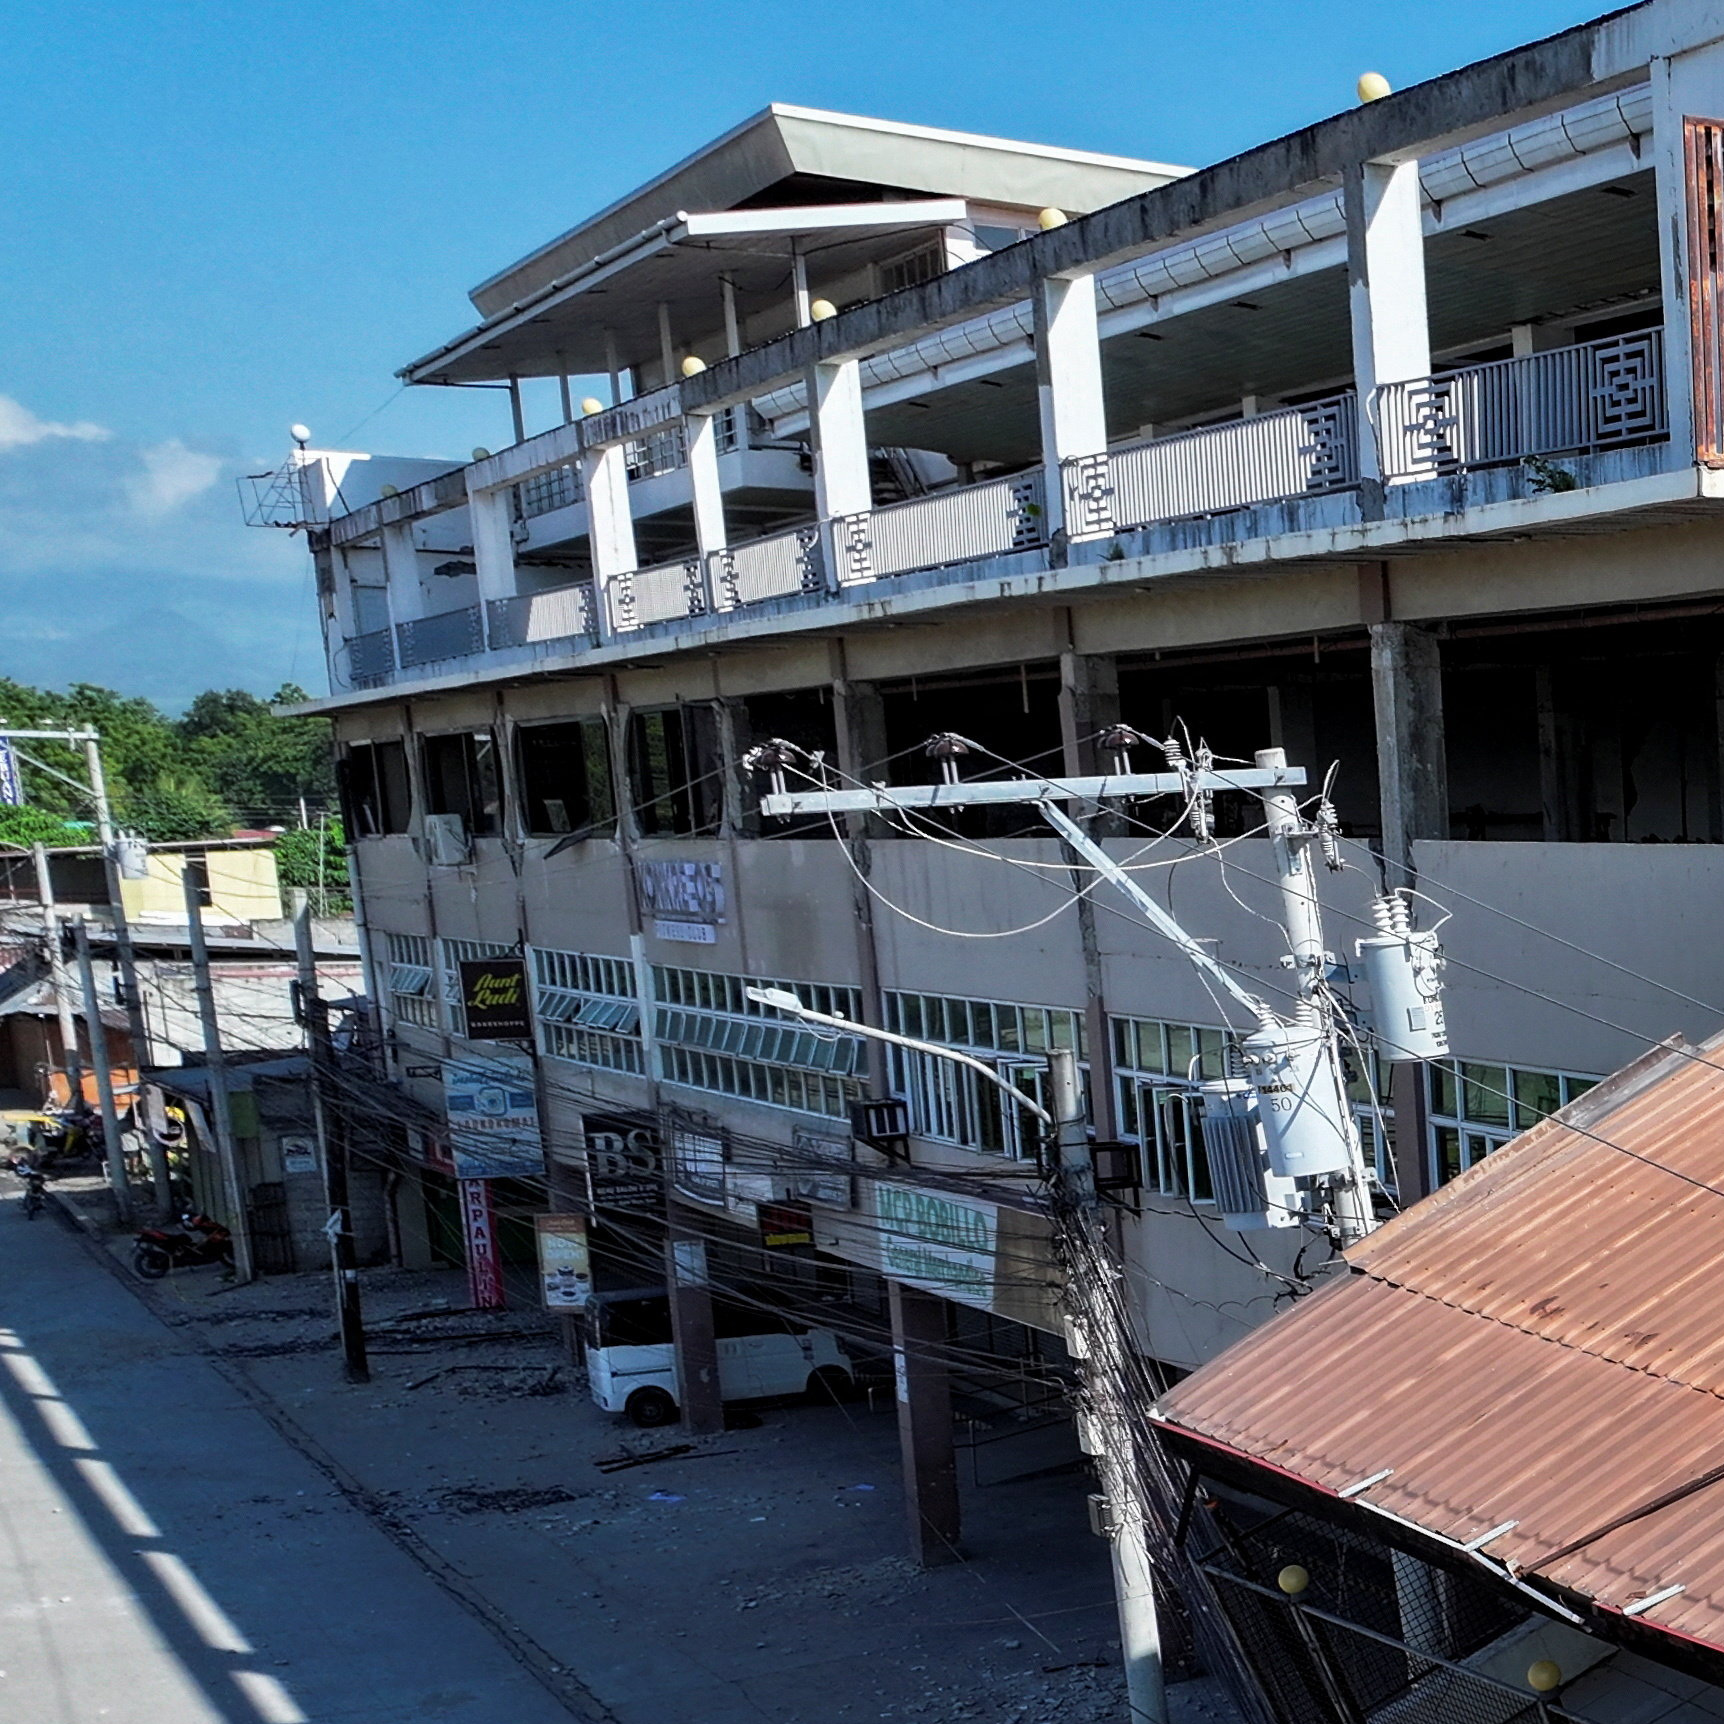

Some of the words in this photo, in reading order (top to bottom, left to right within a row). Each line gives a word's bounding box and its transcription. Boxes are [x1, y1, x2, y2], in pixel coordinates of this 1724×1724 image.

[472, 973, 522, 992] Aunt
[1270, 1097, 1292, 1112] 50
[586, 1129, 656, 1179] BS
